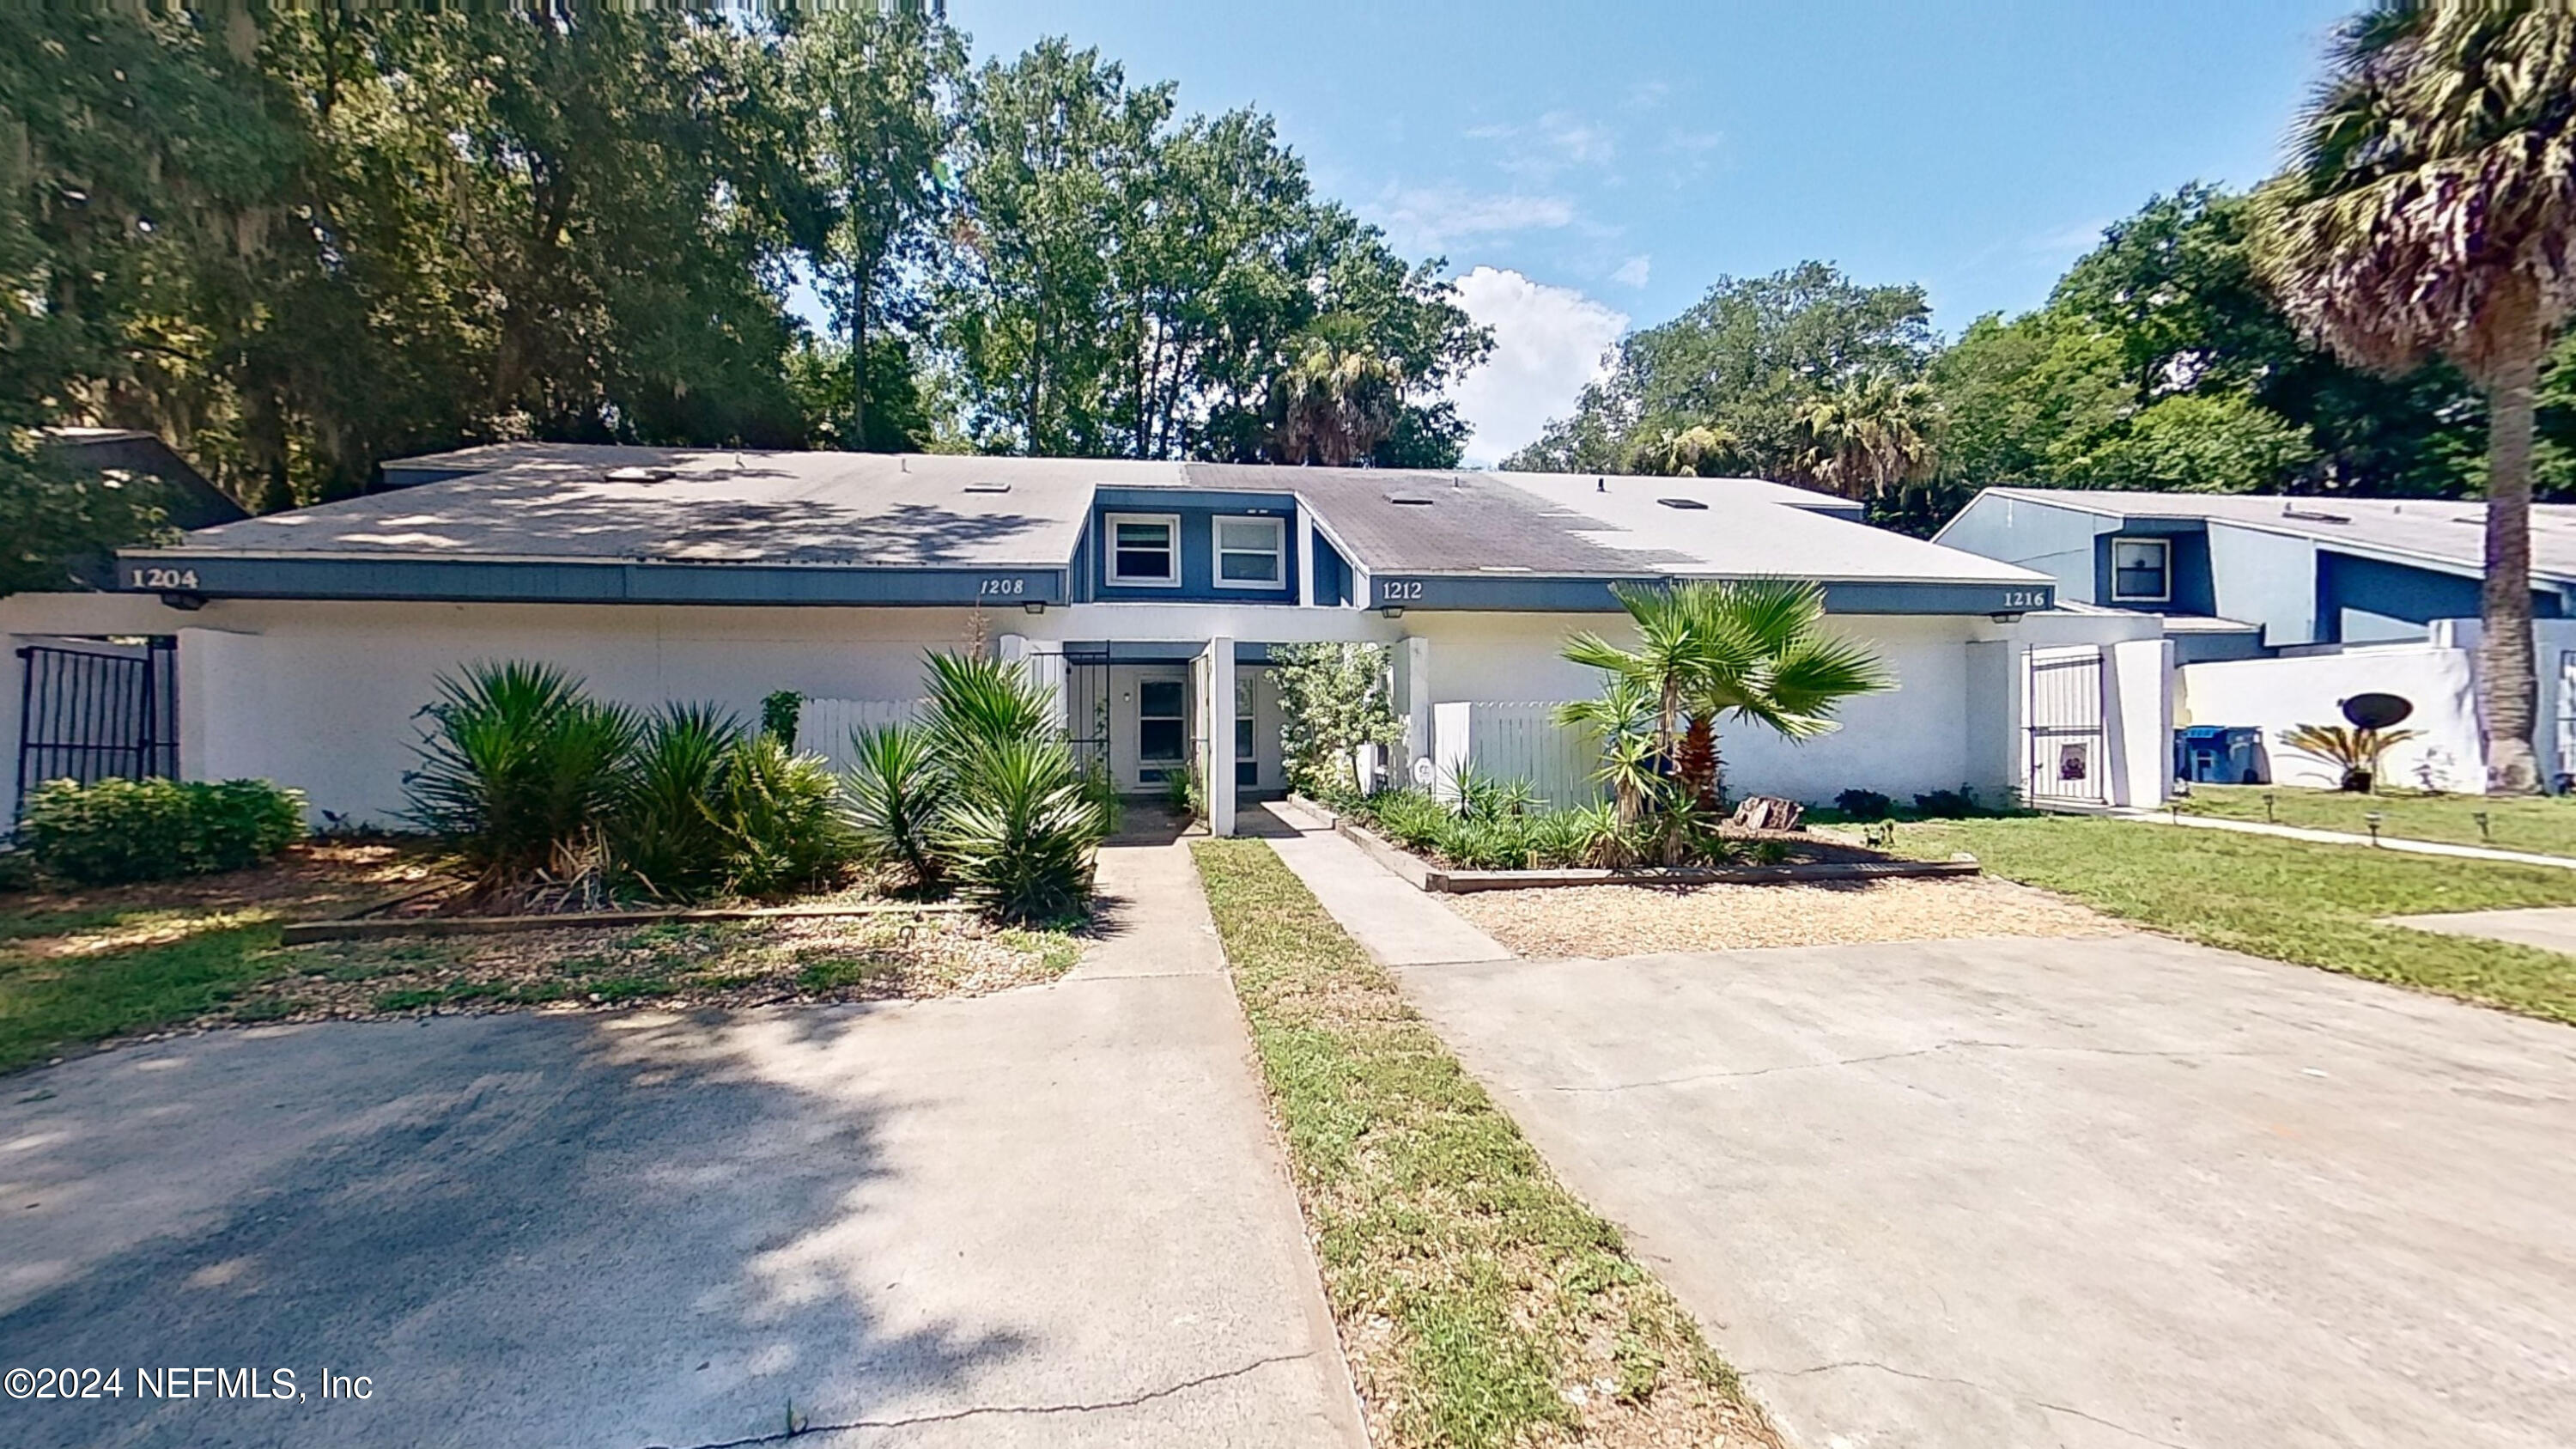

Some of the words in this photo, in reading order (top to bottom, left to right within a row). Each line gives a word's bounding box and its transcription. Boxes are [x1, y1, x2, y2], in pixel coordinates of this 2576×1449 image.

[132, 568, 198, 589] 1204
[980, 579, 1024, 594] 1208
[1383, 581, 1422, 600] 1212
[2004, 592, 2044, 606] 1216
